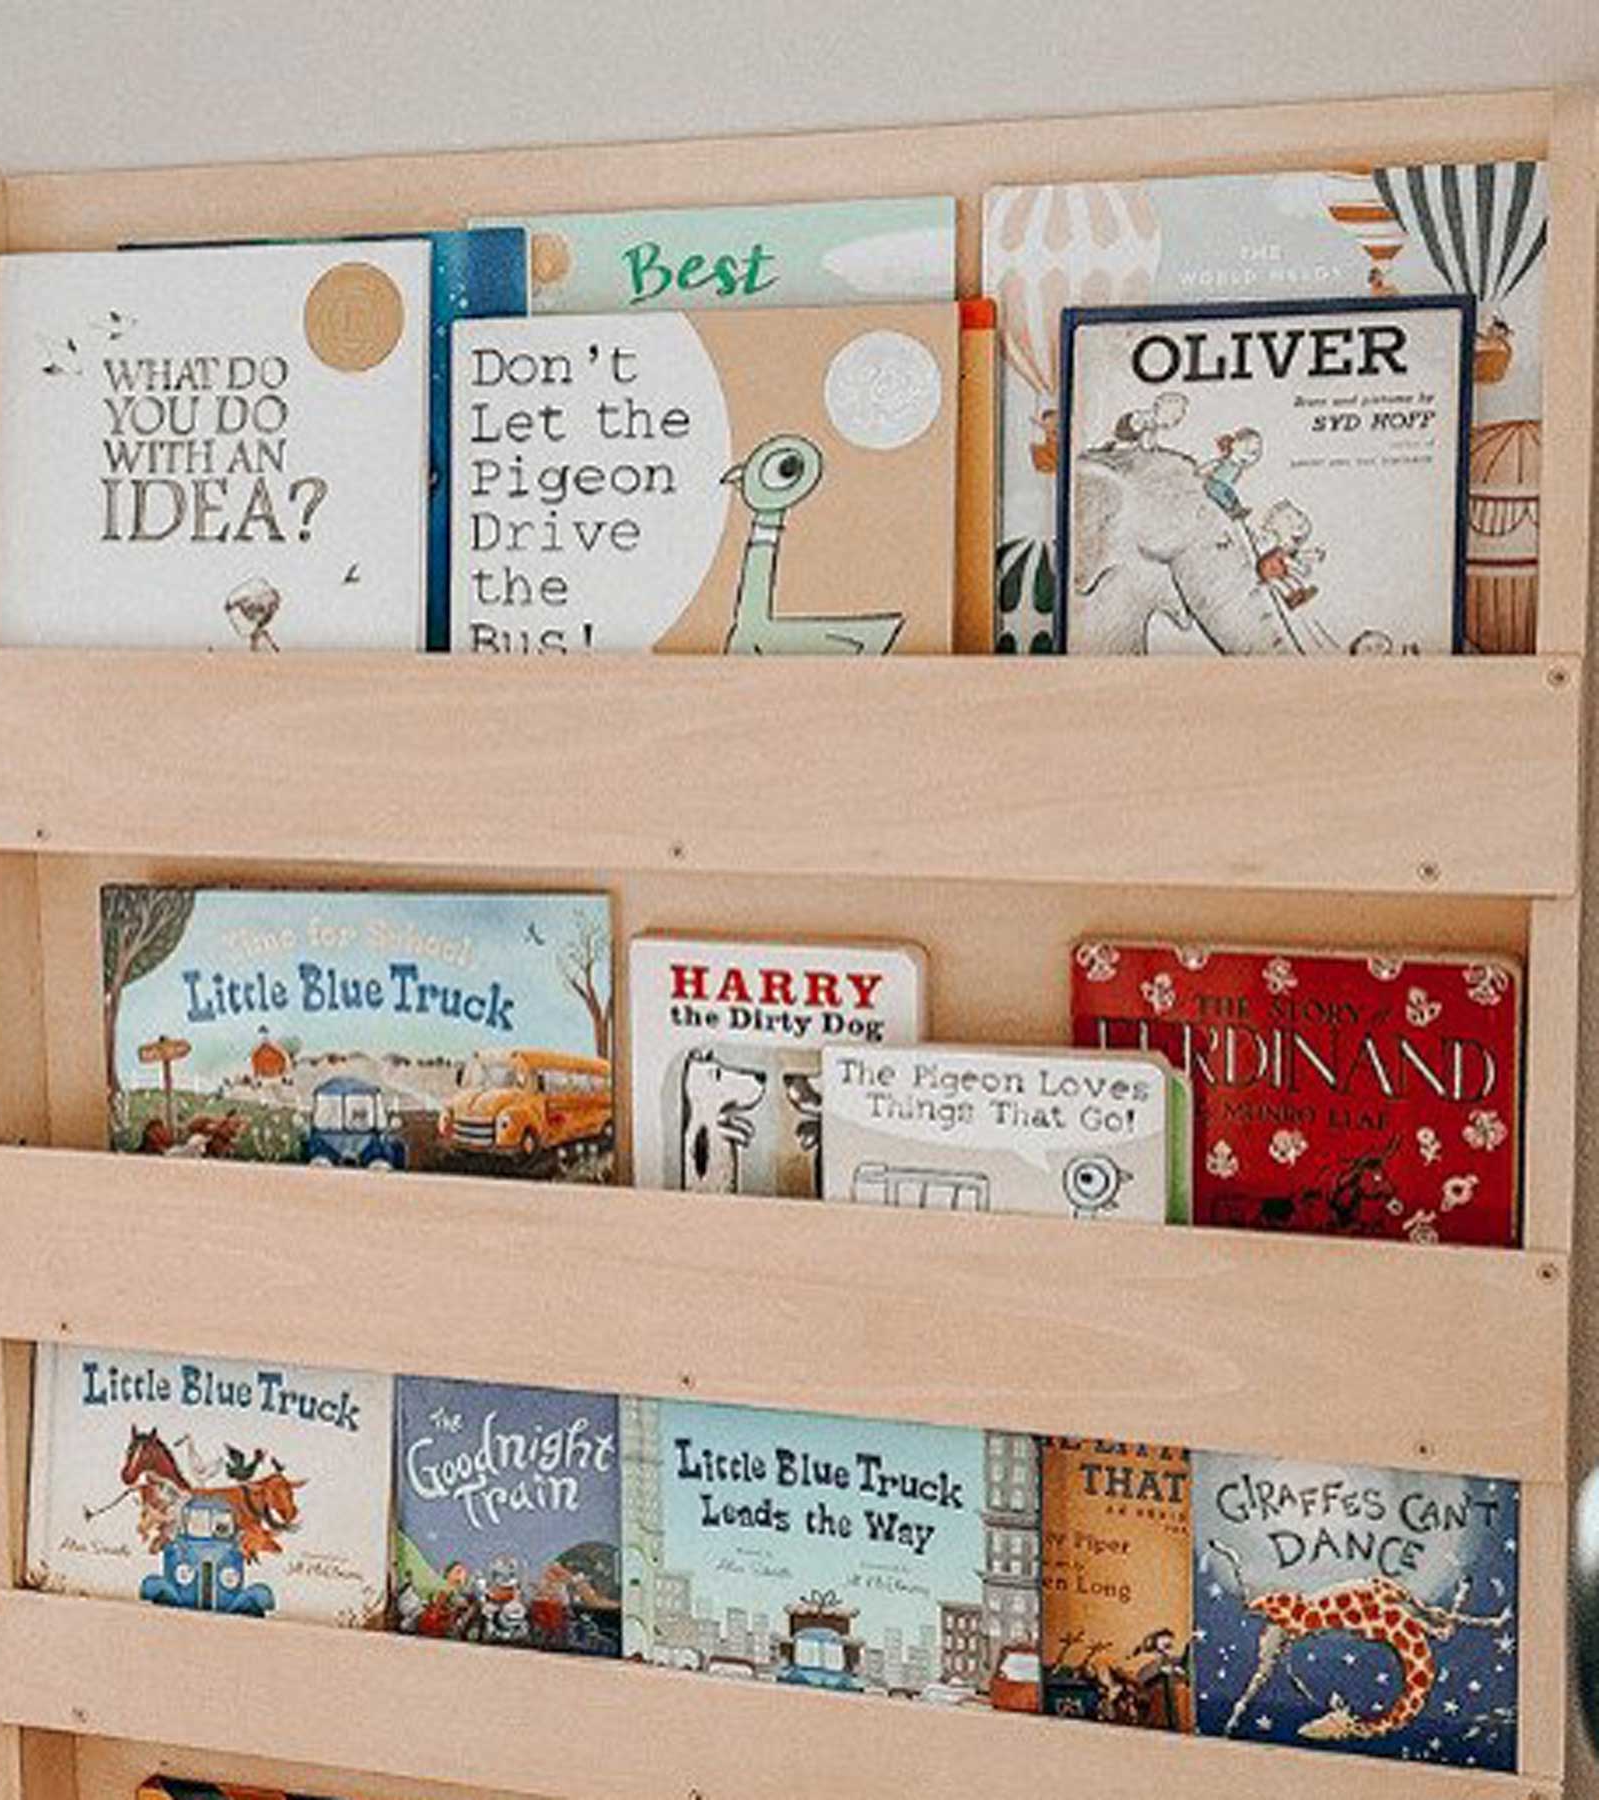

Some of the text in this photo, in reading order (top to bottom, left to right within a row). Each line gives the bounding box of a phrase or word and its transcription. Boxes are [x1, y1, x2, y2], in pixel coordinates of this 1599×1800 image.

[624, 242, 779, 304] Best
[104, 357, 289, 390] WHAT DO
[471, 345, 638, 387] Don't
[1132, 325, 1407, 384] OLIVER
[104, 396, 289, 435] YOU DO
[471, 399, 690, 443] Let the
[1312, 413, 1361, 431] SYD
[104, 440, 287, 473] WITH AN
[471, 456, 676, 504] Pigeon
[101, 477, 328, 542] IDEA?
[471, 510, 641, 553] Drive
[472, 566, 568, 606] the
[308, 916, 356, 947] for
[183, 963, 515, 1032] Little Blue Truck
[670, 964, 883, 1009] HARRY
[671, 1006, 885, 1040] the Dirty Dog
[838, 1059, 1150, 1102] The Pigeon Loves
[868, 1093, 1135, 1132] Things That Go!
[83, 1362, 361, 1432] Little Blue Truck
[408, 1410, 615, 1499] Goodnight
[674, 1439, 964, 1509] Little Blue Truck
[453, 1473, 579, 1529] Train
[1080, 1463, 1189, 1504] THAT
[1217, 1474, 1386, 1524] GIRAFFES
[700, 1494, 935, 1554] Leads the Way
[1074, 1532, 1131, 1556] Piper
[1267, 1527, 1426, 1577] DANCE
[1076, 1576, 1132, 1604] Long
